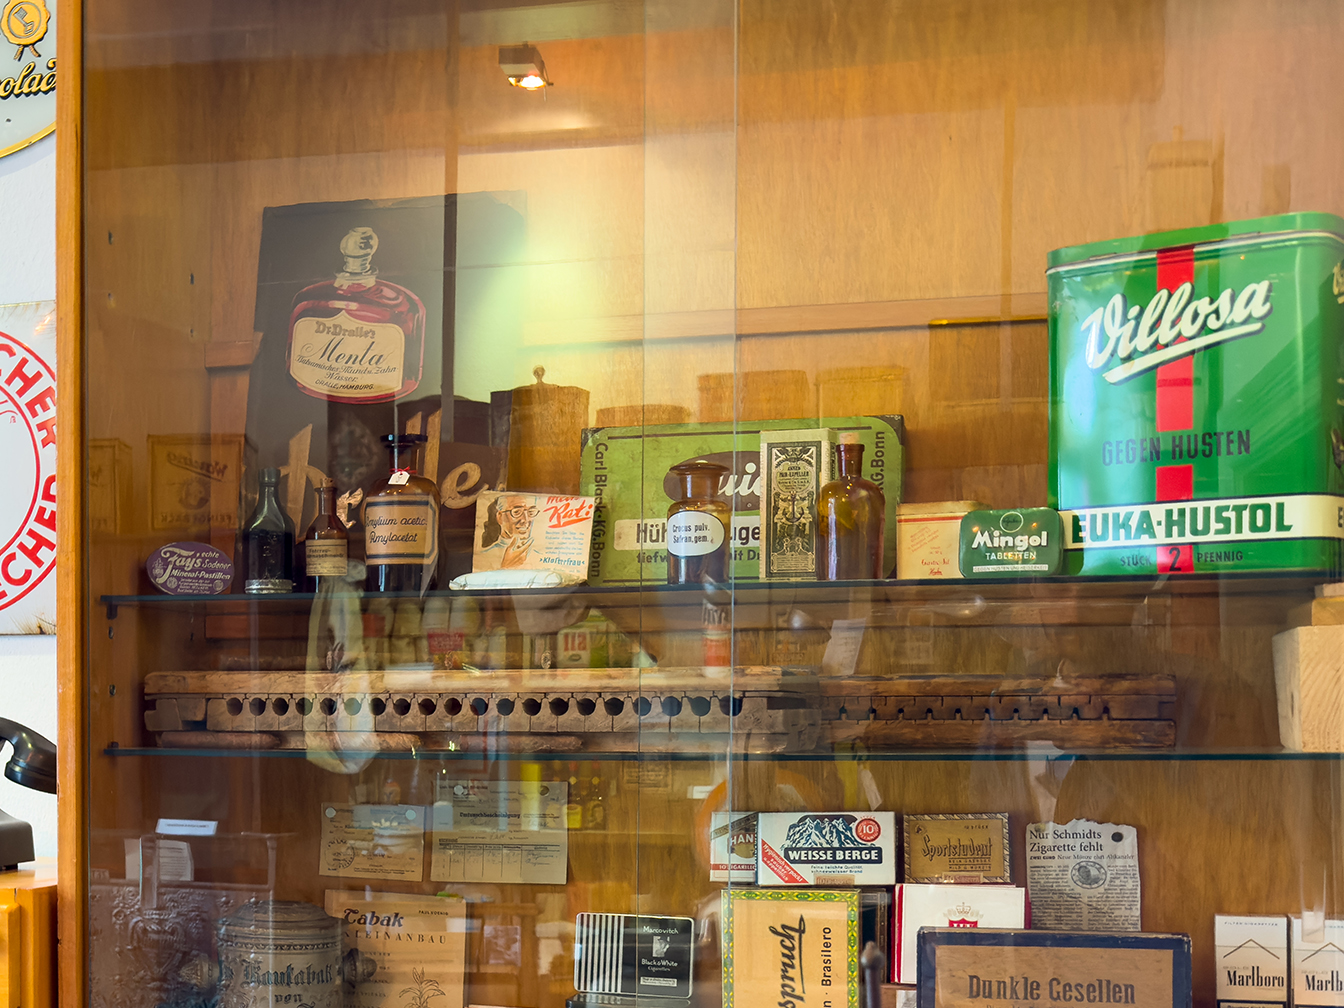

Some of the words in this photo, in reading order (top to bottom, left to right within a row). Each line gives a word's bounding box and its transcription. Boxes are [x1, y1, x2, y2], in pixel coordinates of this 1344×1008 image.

[1080, 280, 1273, 373] Villosa
[301, 337, 387, 366] Menta
[594, 442, 608, 471] Carl
[1102, 437, 1161, 468] GEGEN
[1171, 429, 1251, 461] HUSTEN
[543, 500, 594, 526] Rat:
[1072, 502, 1293, 544] EUKA-HUSTOL
[672, 523, 692, 533] Crocus
[694, 522, 710, 534] pulv.
[972, 530, 1048, 550] Mingol
[156, 547, 202, 584] Fay's
[202, 559, 231, 569] Sodener
[985, 551, 1036, 561] TABLETTEN
[1120, 552, 1152, 568] STÜCK
[1168, 546, 1182, 572] 2
[1196, 550, 1244, 564] PFENNIG
[171, 569, 231, 580] Mineral-Pastillen
[731, 834, 755, 844] HAN
[863, 825, 874, 834] 10
[1030, 829, 1049, 840] Nur
[1053, 829, 1102, 840] Schmidts
[788, 850, 833, 861] WEISSE
[836, 850, 879, 861] BERGE
[922, 834, 992, 861] Sportstudent
[1030, 842, 1076, 855] Zigarette
[1080, 842, 1103, 852] fehlt
[344, 908, 404, 928] Tabak
[643, 925, 679, 934] Marcovitch
[820, 926, 832, 987] Brasilero
[1227, 965, 1284, 987] Marlboro
[1305, 970, 1343, 991] Marlb
[275, 993, 303, 1004] von
[968, 974, 1041, 1001] Dunkle
[1048, 977, 1136, 1004] Gesellen
